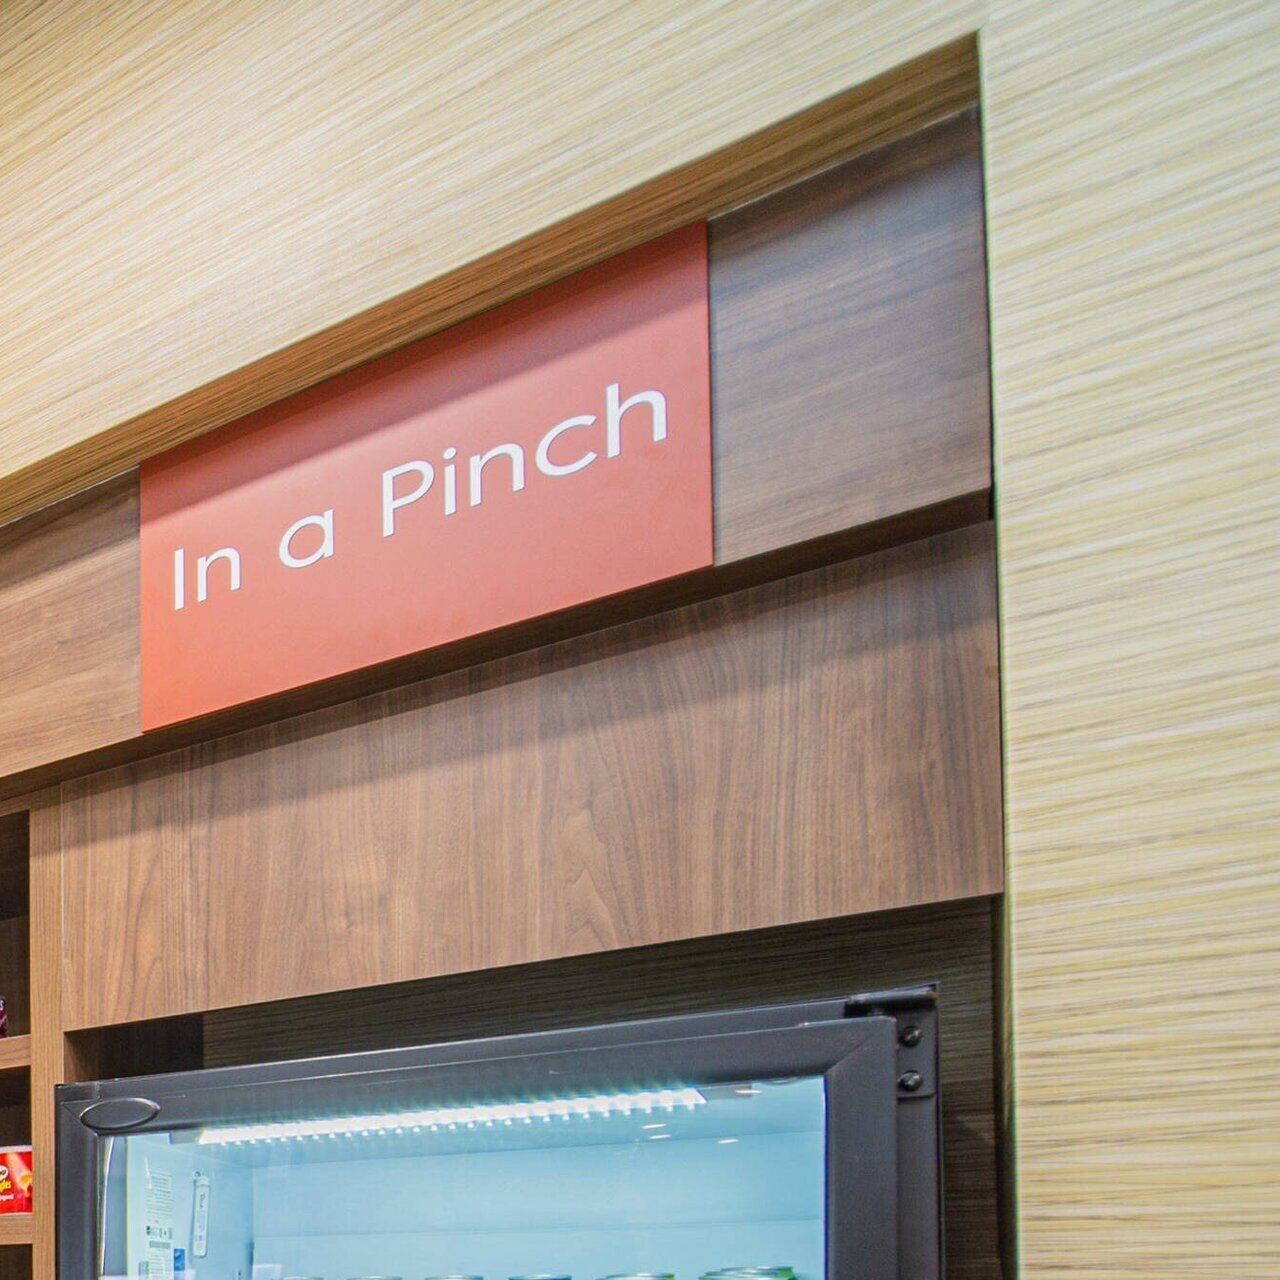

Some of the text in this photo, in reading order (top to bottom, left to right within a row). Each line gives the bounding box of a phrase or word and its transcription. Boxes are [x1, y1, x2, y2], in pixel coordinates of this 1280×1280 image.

[172, 382, 668, 611] In a Pinch
